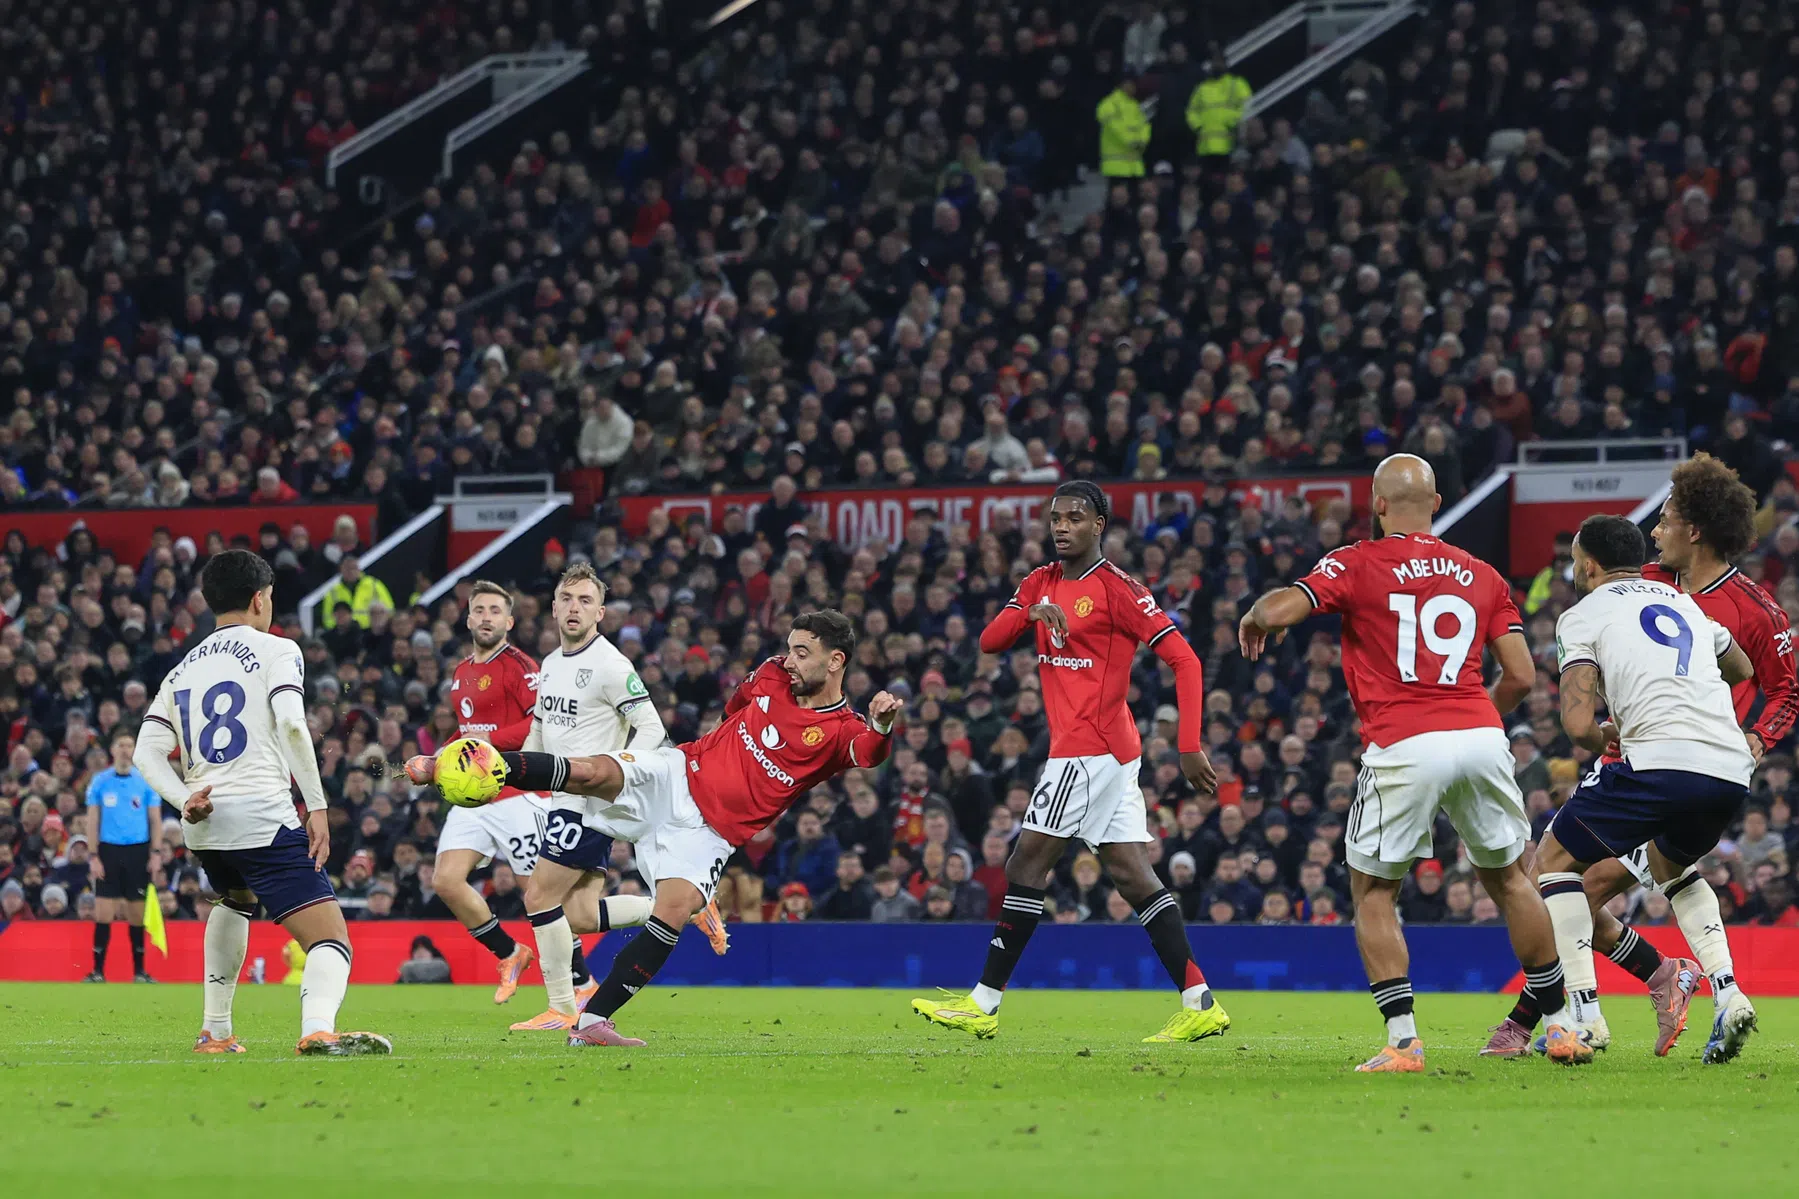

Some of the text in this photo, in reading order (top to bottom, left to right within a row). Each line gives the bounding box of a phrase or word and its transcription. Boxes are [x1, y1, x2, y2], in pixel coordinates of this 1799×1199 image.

[1392, 557, 1475, 587] MBEUMO
[1388, 593, 1477, 685] 19
[1639, 603, 1694, 677] 9
[173, 680, 248, 770] 18
[546, 714, 577, 729] SPORTS
[1033, 781, 1053, 809] 6
[509, 834, 540, 860] 23
[546, 815, 583, 850] 20
